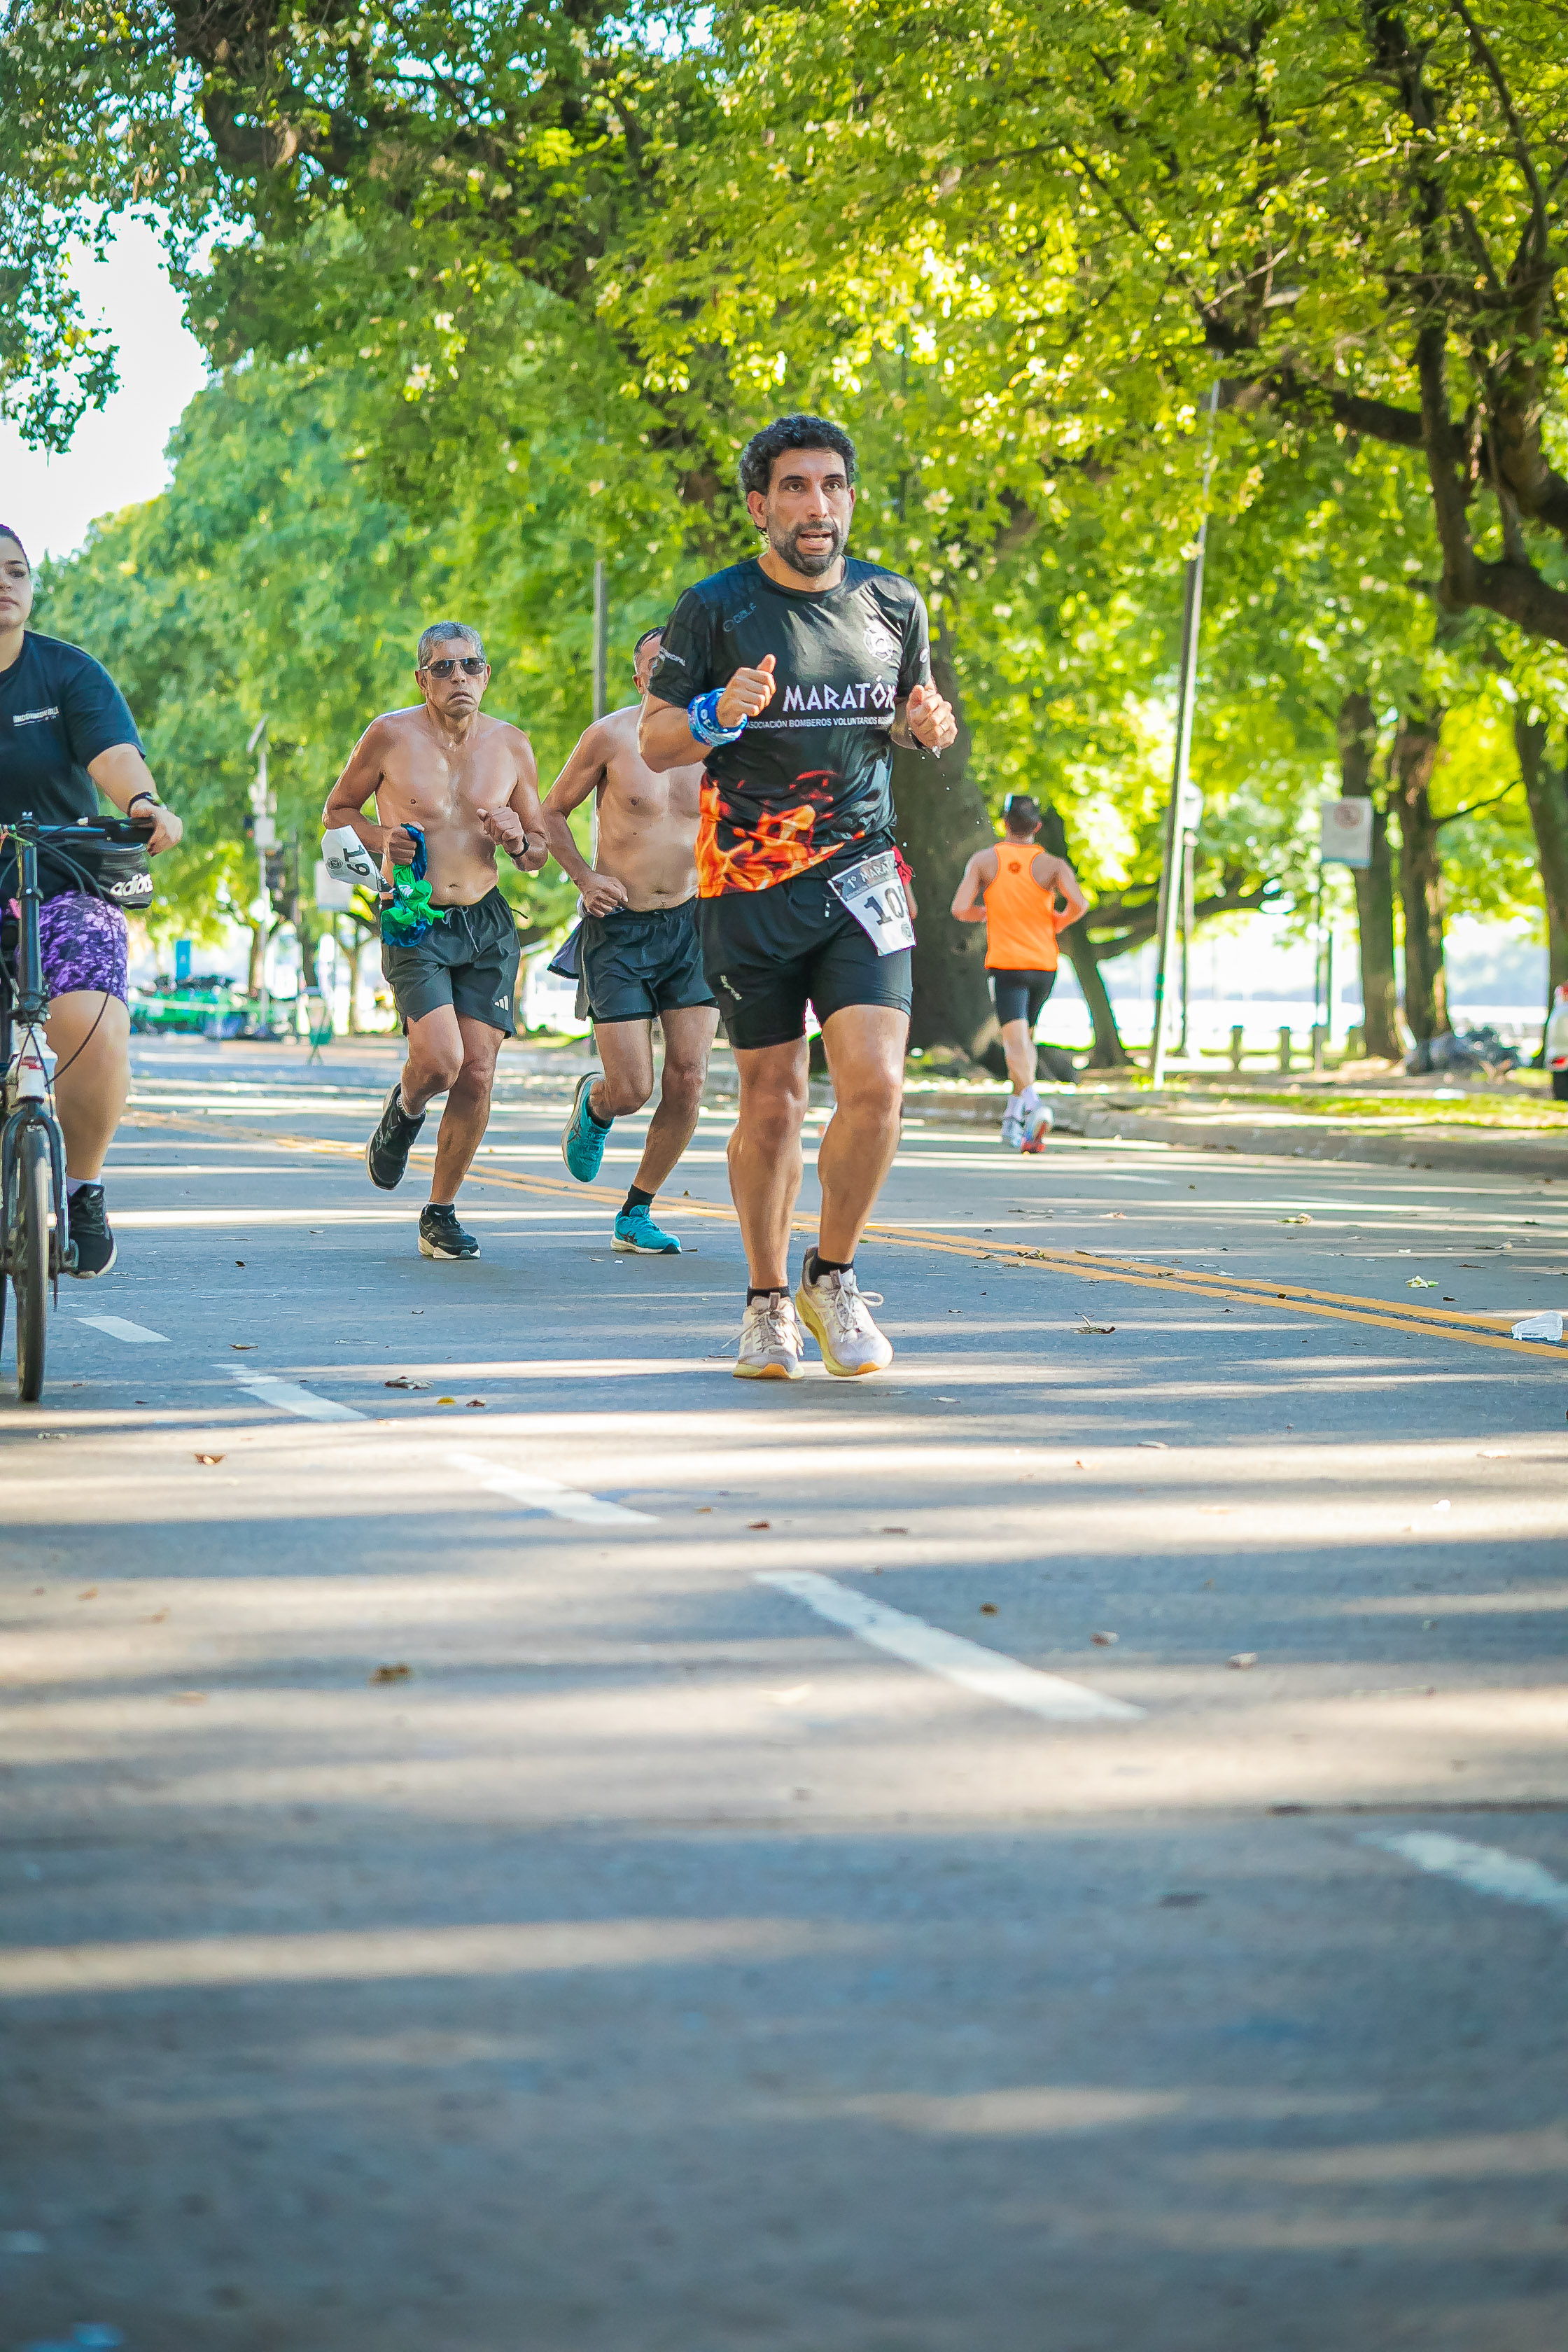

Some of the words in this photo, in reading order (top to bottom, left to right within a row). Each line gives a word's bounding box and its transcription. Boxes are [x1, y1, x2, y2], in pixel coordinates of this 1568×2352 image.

[782, 674, 896, 712] MARATÓN
[788, 718, 832, 728] BOMBEROS
[833, 716, 878, 726] VOLUNTARIOS
[860, 860, 894, 883] MARAT
